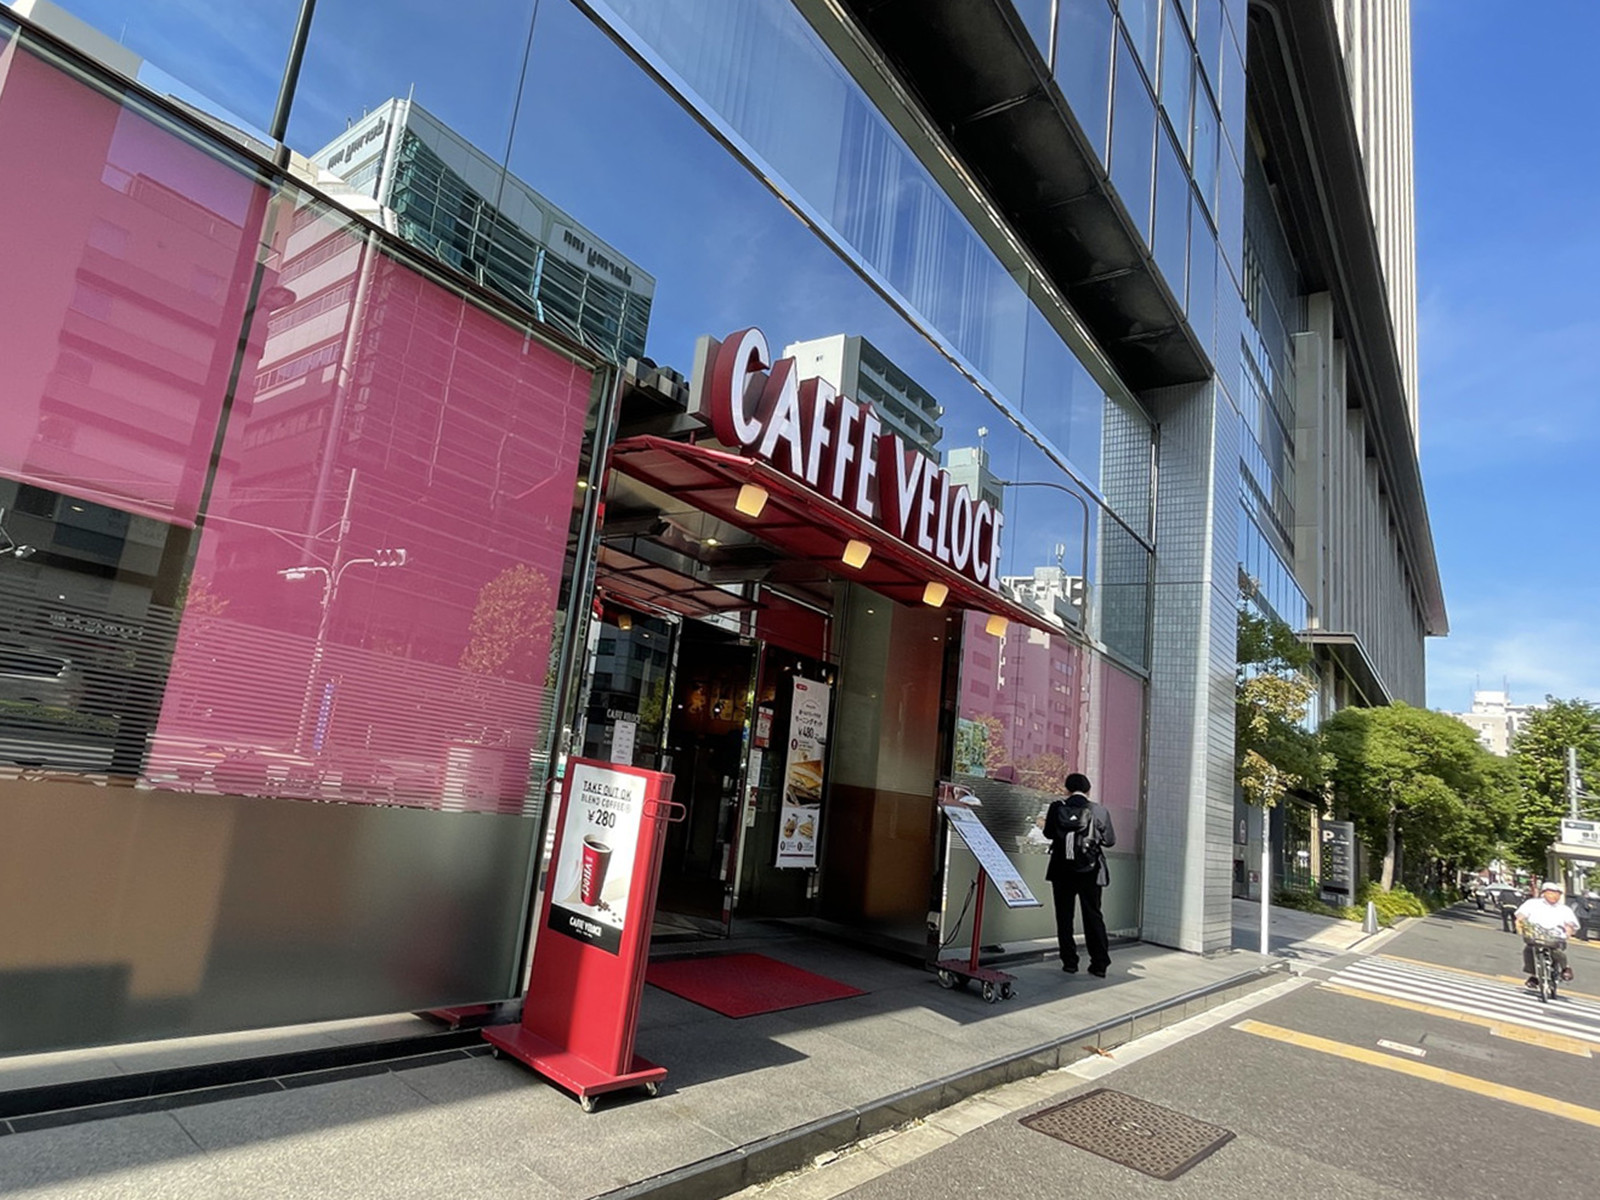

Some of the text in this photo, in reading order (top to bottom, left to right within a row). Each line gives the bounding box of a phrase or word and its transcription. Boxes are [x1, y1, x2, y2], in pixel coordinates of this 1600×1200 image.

[894, 434, 1004, 593] VELOCE
[583, 780, 603, 794] TAKE
[620, 788, 632, 801] OK
[587, 808, 617, 829] ¥280
[1322, 830, 1335, 842] P
